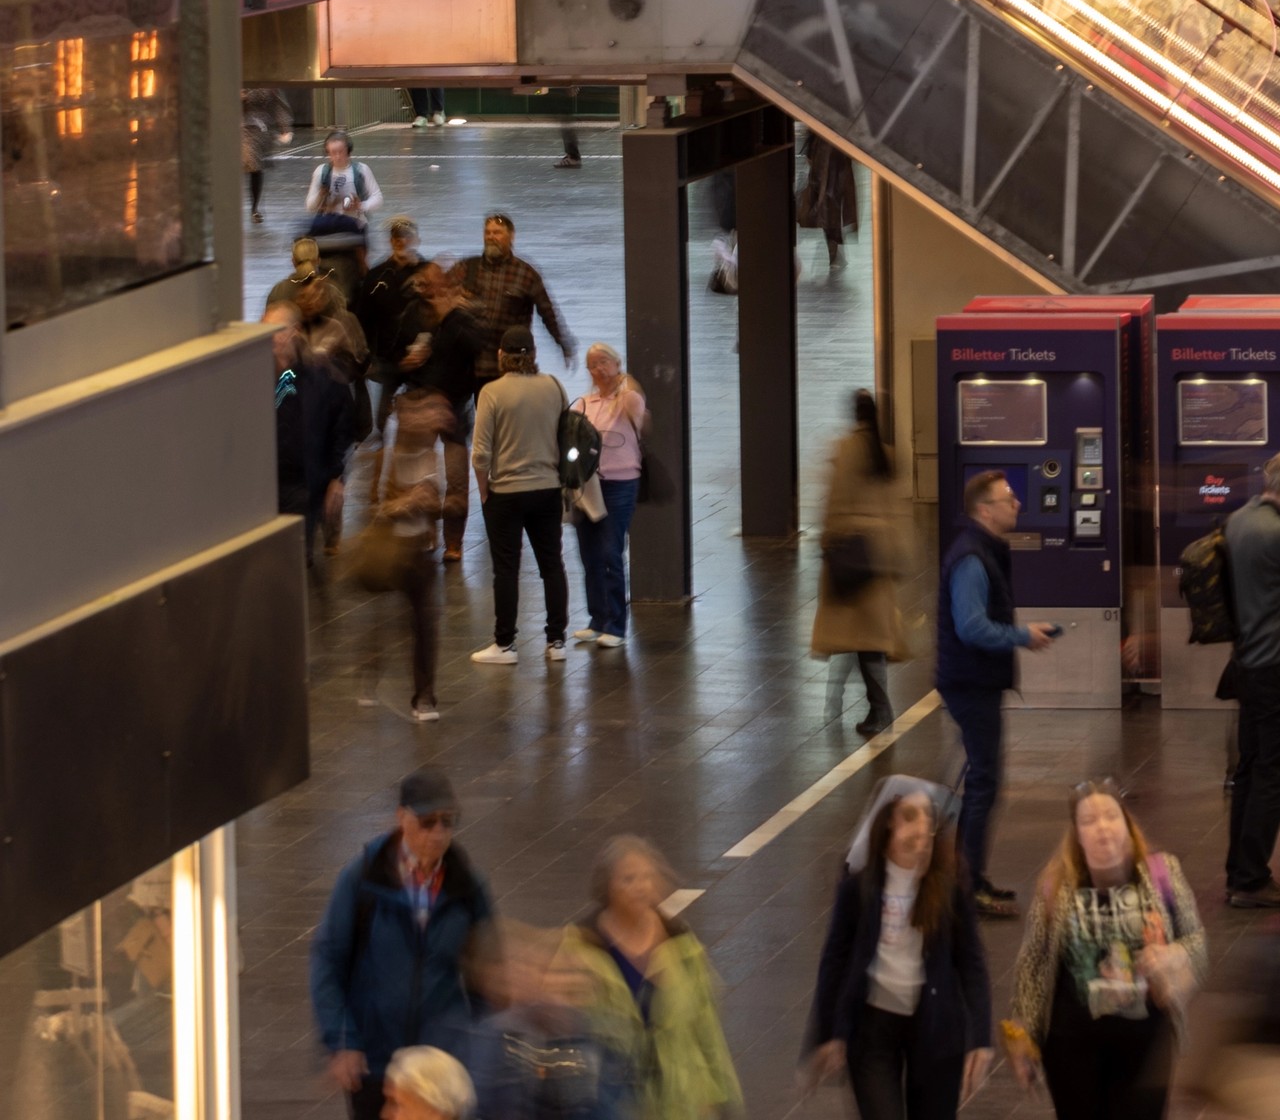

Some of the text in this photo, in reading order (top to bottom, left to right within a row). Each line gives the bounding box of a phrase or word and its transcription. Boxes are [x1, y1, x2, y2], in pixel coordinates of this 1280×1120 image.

[952, 348, 1057, 361] Billetter Tickets
[1171, 348, 1277, 361] Billetter Tickets
[1205, 475, 1225, 485] Buy
[1199, 485, 1231, 495] tickets
[1204, 495, 1226, 504] here
[1103, 609, 1120, 621] 01
